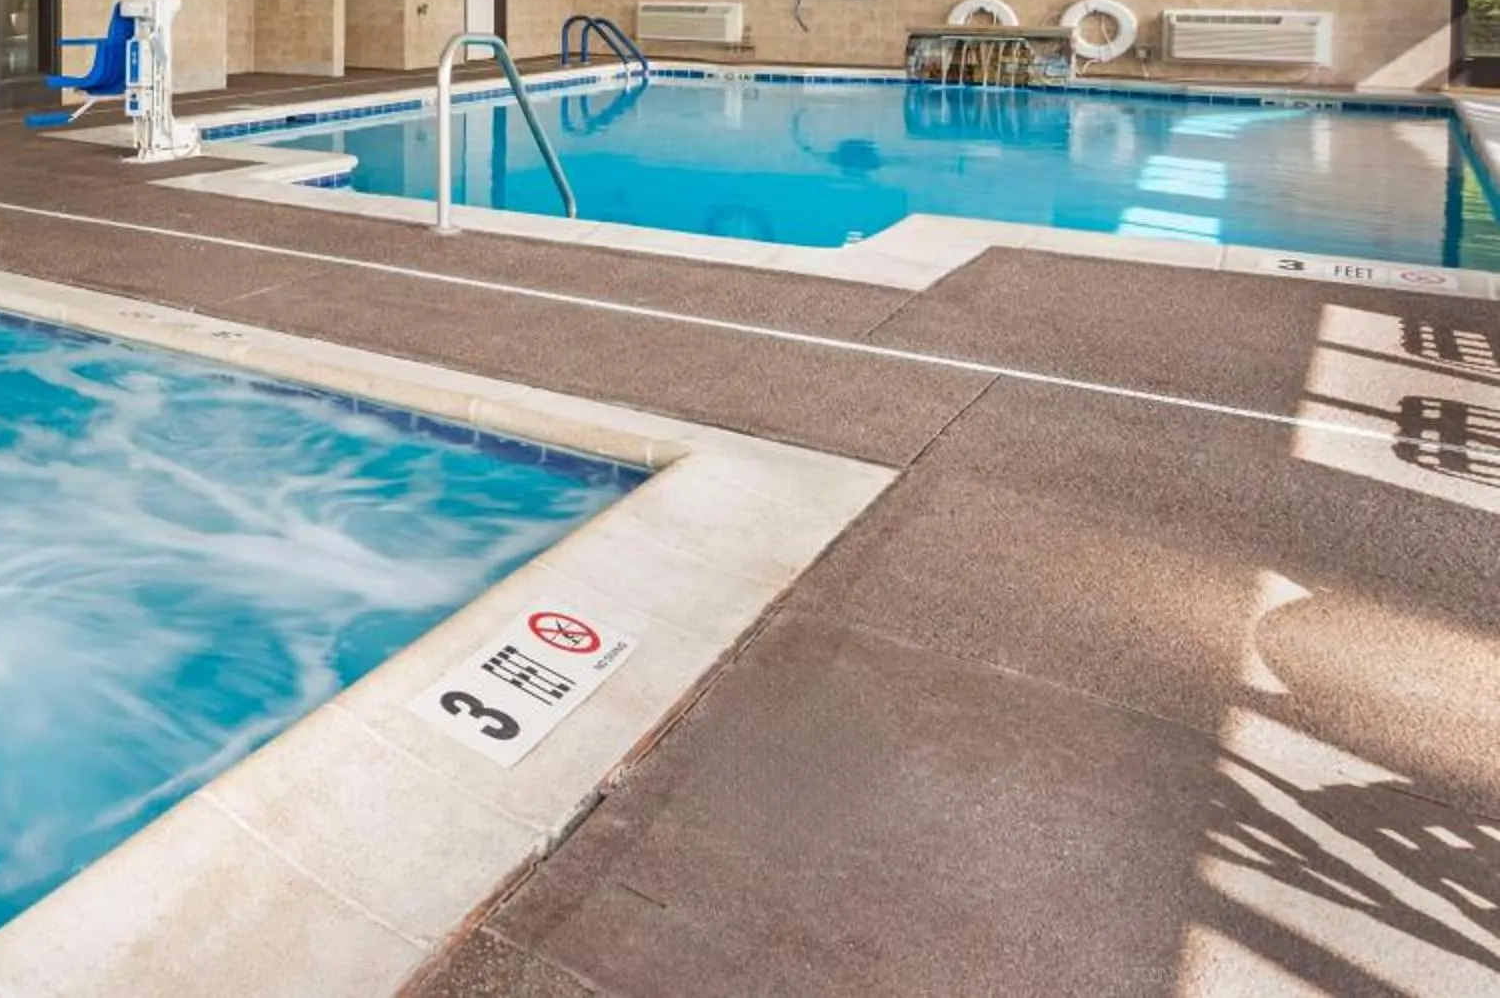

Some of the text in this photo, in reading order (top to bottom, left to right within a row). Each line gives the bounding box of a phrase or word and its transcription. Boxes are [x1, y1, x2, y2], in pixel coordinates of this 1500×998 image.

[1278, 259, 1373, 280] 3 FEET
[439, 690, 520, 740] 3
[481, 645, 576, 706] FEET
